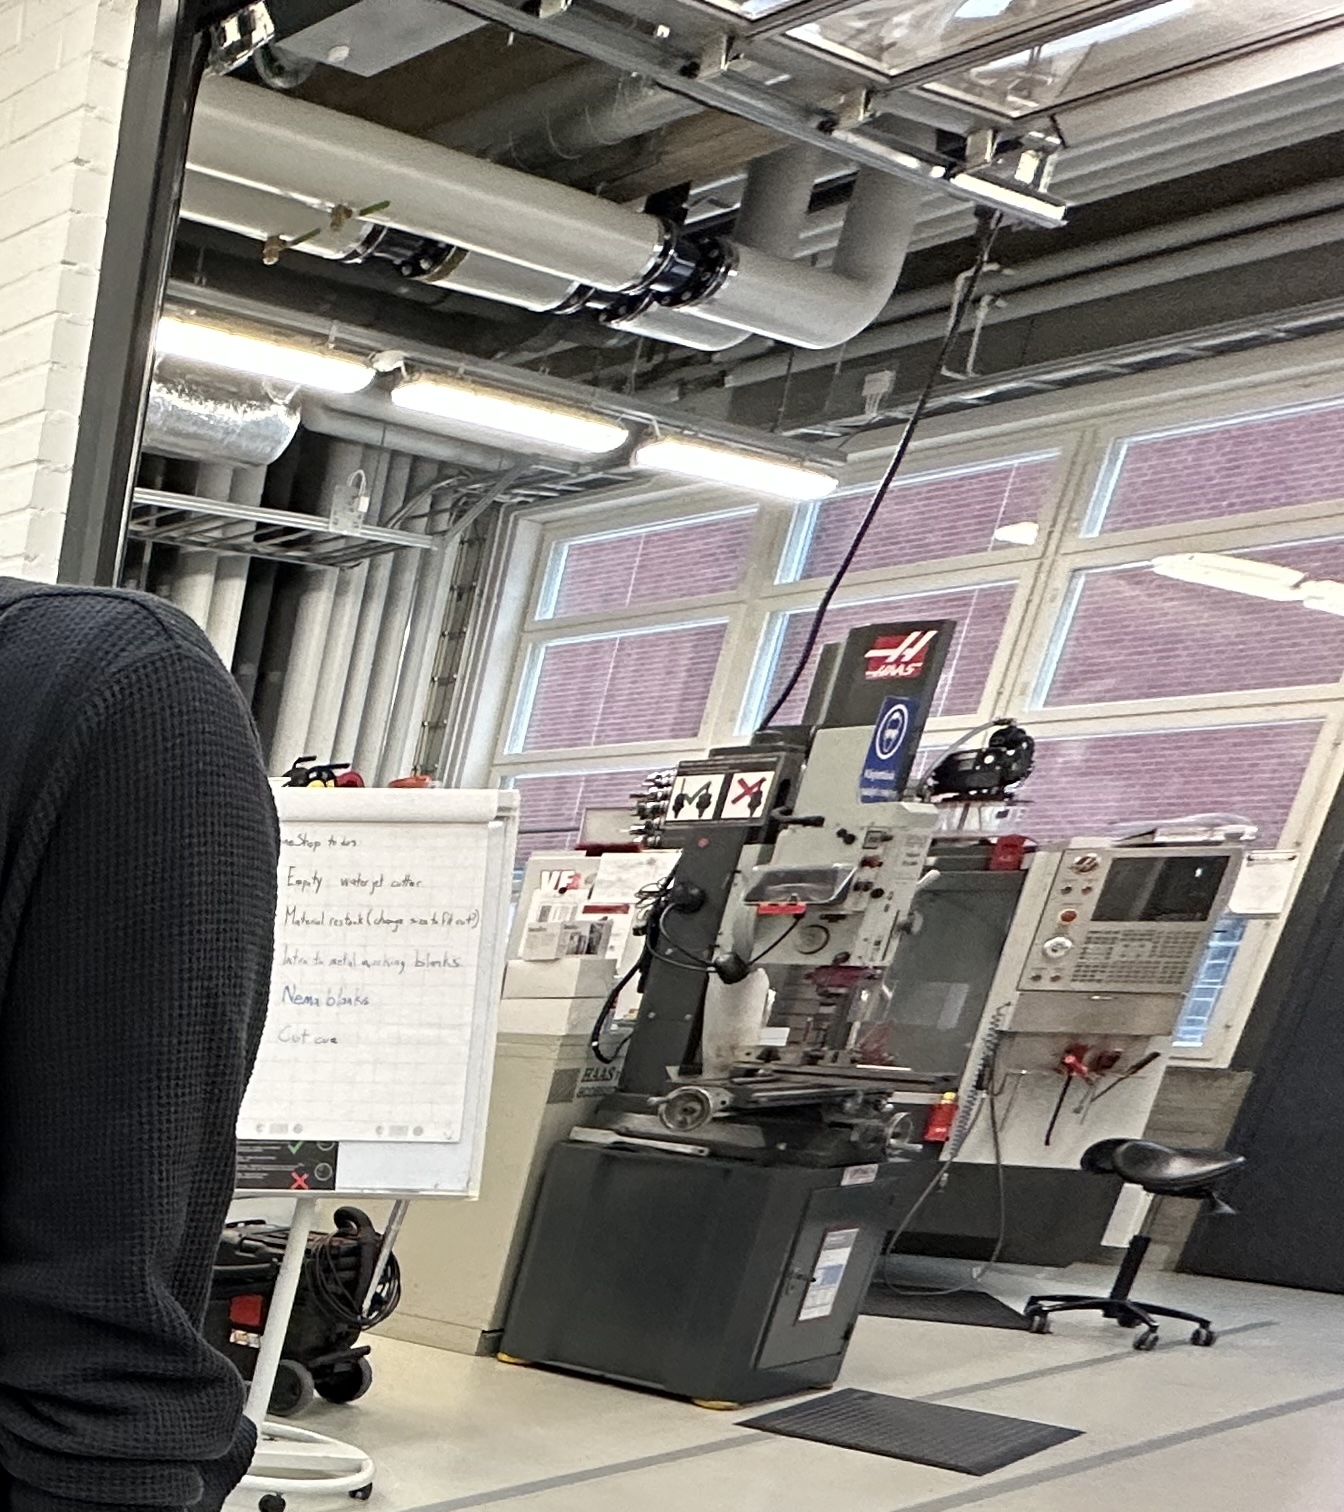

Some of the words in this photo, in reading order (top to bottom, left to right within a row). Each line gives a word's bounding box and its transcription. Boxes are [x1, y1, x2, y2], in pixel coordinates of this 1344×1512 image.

[865, 662, 923, 677] HAAS
[287, 866, 323, 894] Empty
[284, 905, 325, 927] Material
